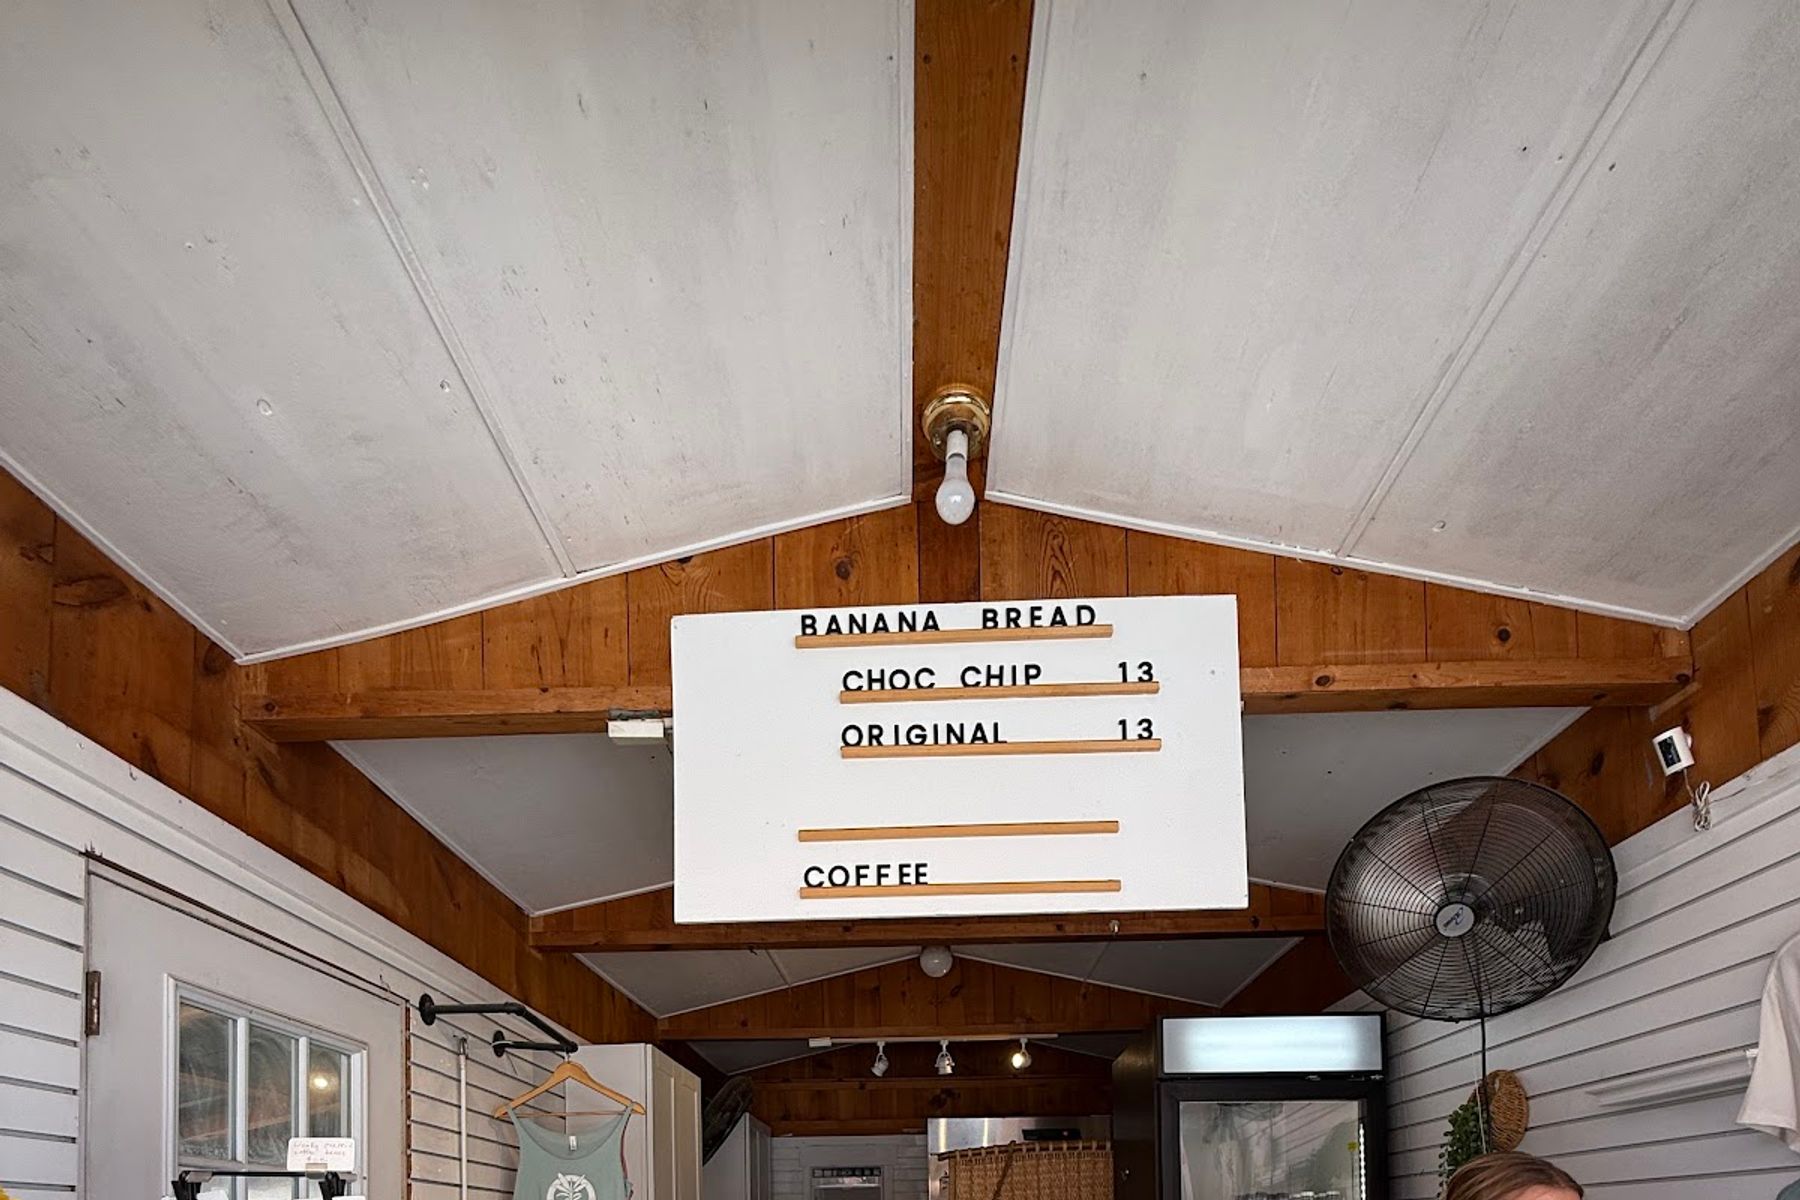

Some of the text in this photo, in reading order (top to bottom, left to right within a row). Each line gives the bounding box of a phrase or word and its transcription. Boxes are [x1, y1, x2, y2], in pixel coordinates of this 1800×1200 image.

[800, 604, 1097, 637] BANANA BREAD
[841, 661, 1154, 692] CHOC CHIP 13
[840, 718, 1154, 747] ORIGINAL 13
[803, 862, 929, 888] COFFEE
